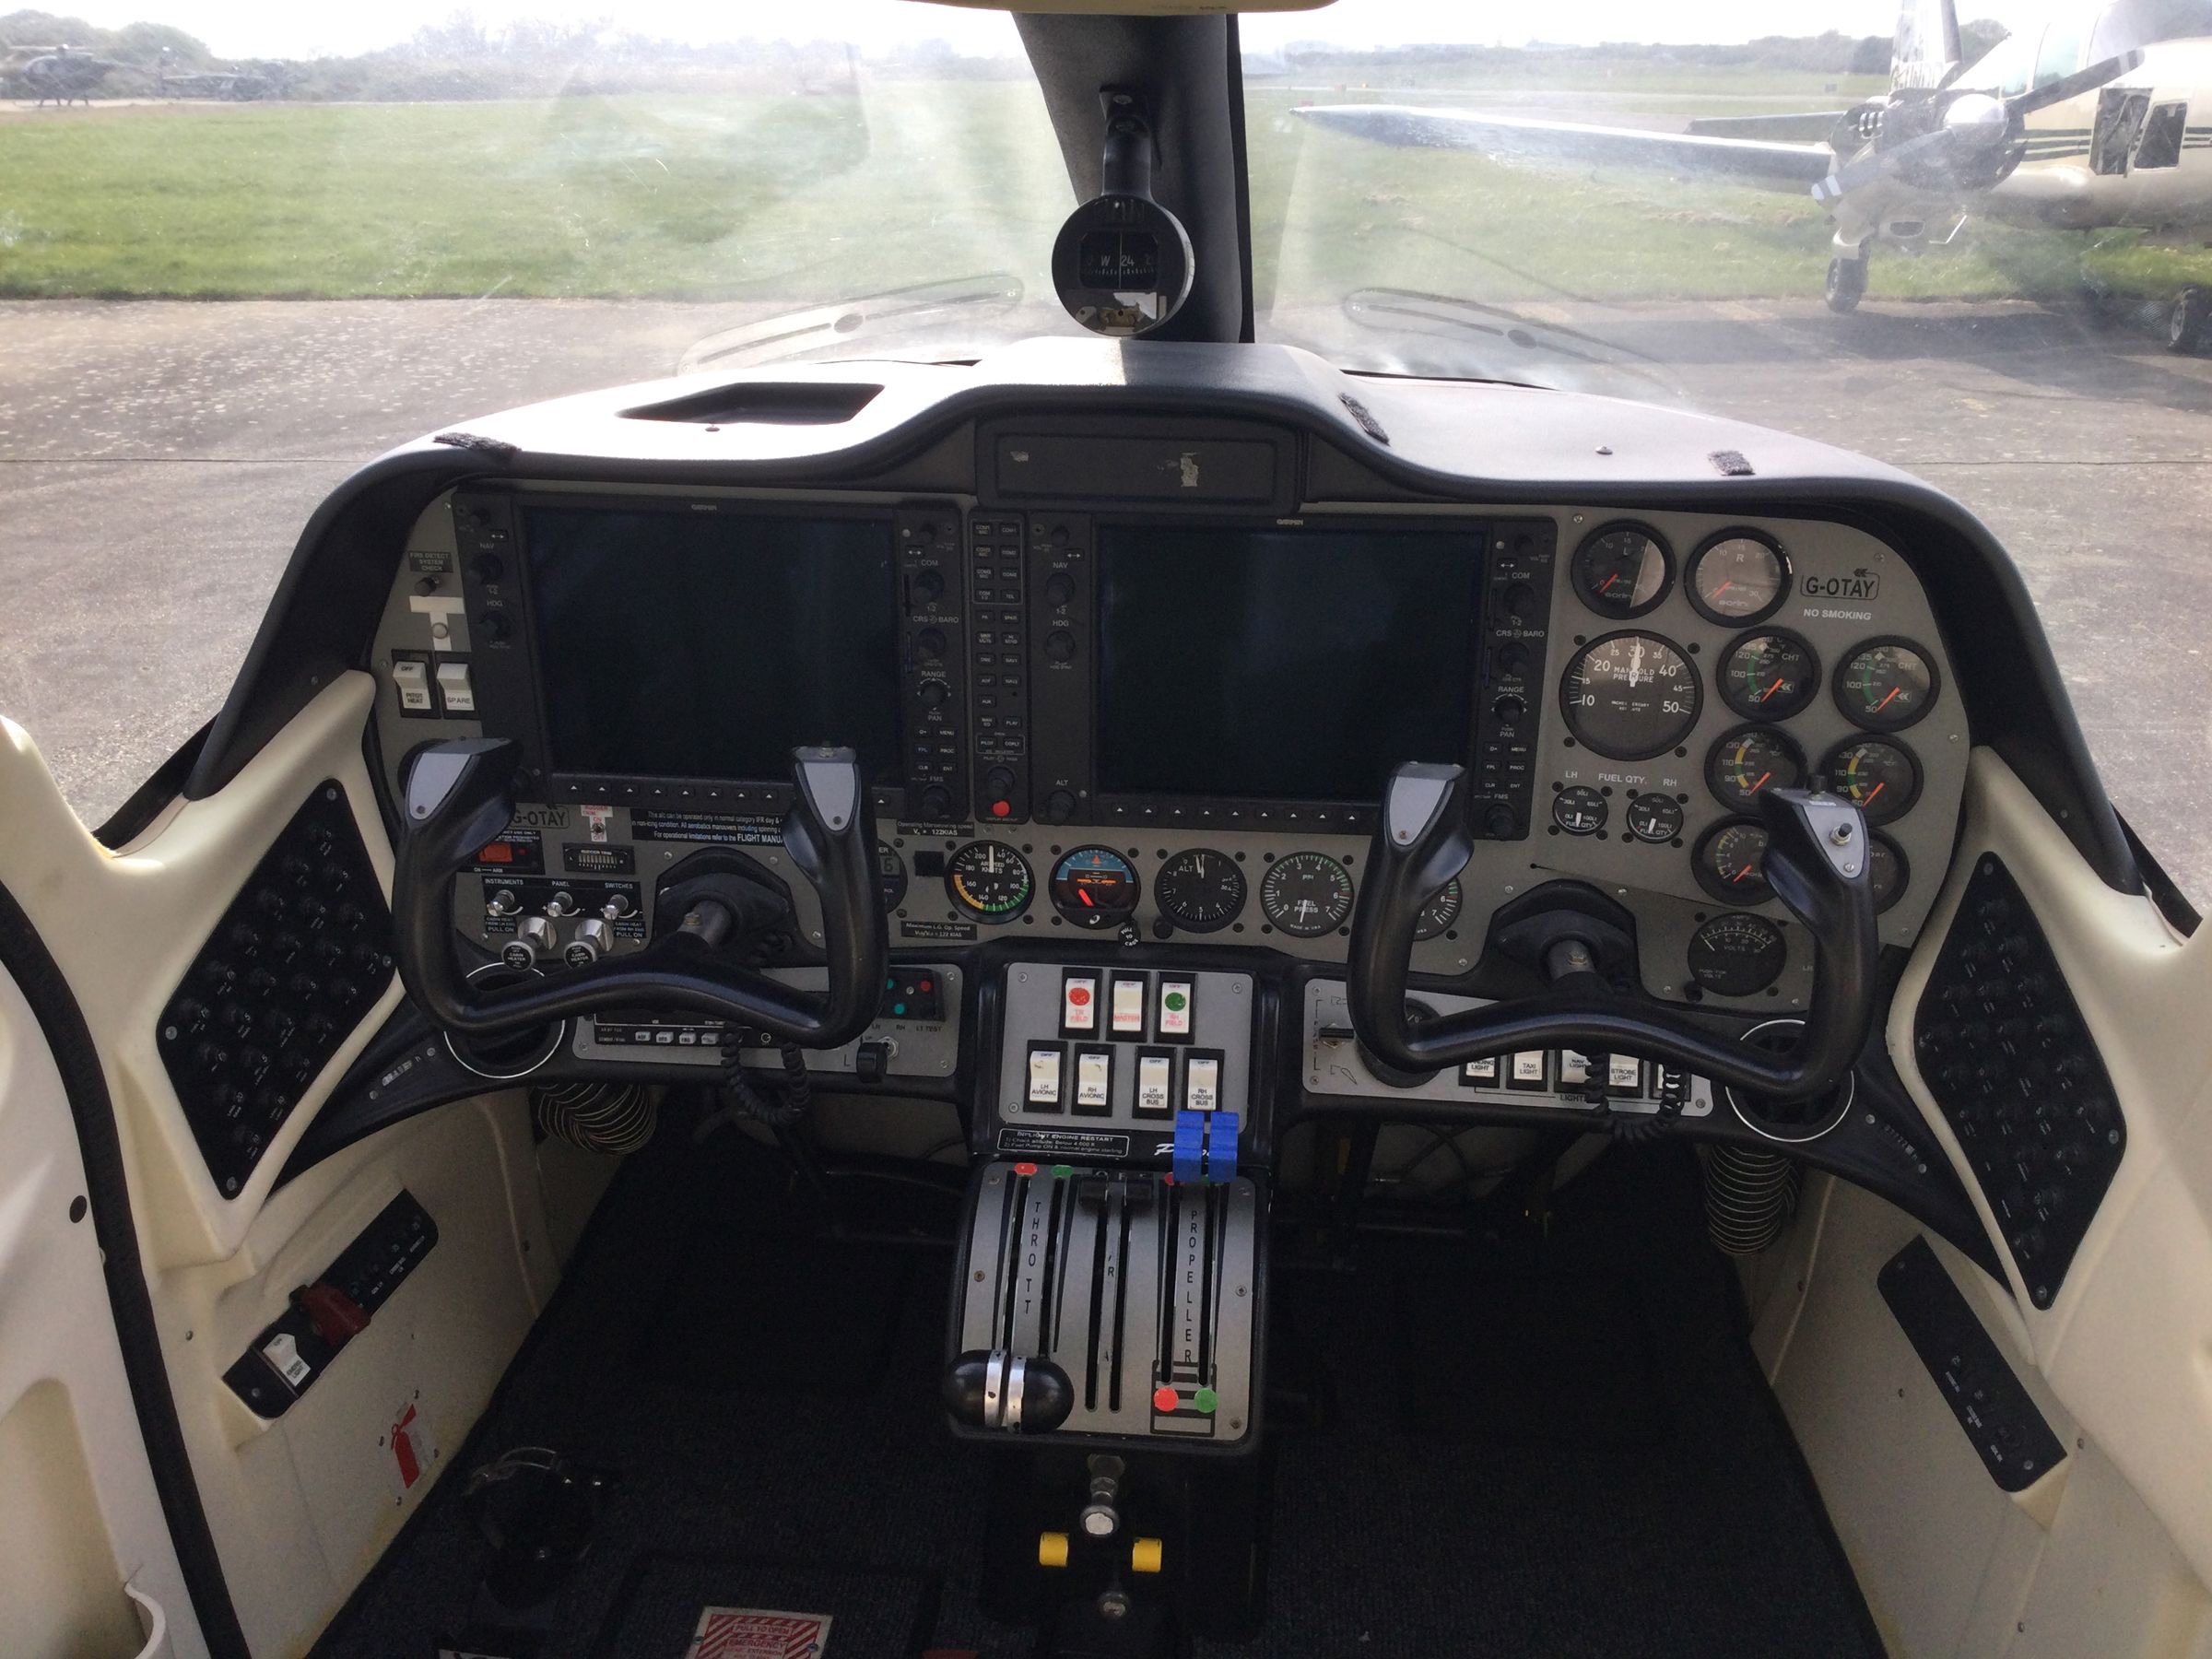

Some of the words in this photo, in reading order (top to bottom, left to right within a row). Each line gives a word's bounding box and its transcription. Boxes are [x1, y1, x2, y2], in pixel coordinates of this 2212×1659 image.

[1100, 255, 1111, 266] W
[1120, 255, 1135, 267] 24
[1735, 554, 1745, 563] R
[1053, 561, 1069, 569] NAV
[1806, 576, 1875, 598] G-OTAY
[1803, 608, 1819, 618] NO
[1822, 610, 1872, 621] SMOKING
[912, 615, 929, 624] CRS
[938, 616, 959, 624] BARO
[1053, 619, 1070, 628] HDG
[1495, 629, 1512, 637] CRS
[1523, 629, 1545, 638] BARO
[1628, 646, 1645, 658] 30
[1735, 651, 1751, 659] 120
[1781, 653, 1800, 661] CHT
[1594, 660, 1611, 671] 20
[1898, 662, 1917, 671] CHT
[1659, 665, 1677, 677] 40
[1581, 694, 1595, 706] 10
[1662, 701, 1679, 713] 50
[1865, 705, 1877, 713] 50
[1565, 771, 1578, 779] LH
[1598, 773, 1621, 782] FUEL
[1663, 778, 1677, 787] RH
[512, 810, 565, 827] G-OTAY
[765, 817, 775, 825] day
[663, 831, 688, 840] operational
[738, 833, 760, 842] FLIGHT
[1185, 1210, 1198, 1363] PROPELLER
[735, 1624, 753, 1632] PULL
[728, 1639, 784, 1649] EMERGENCY
